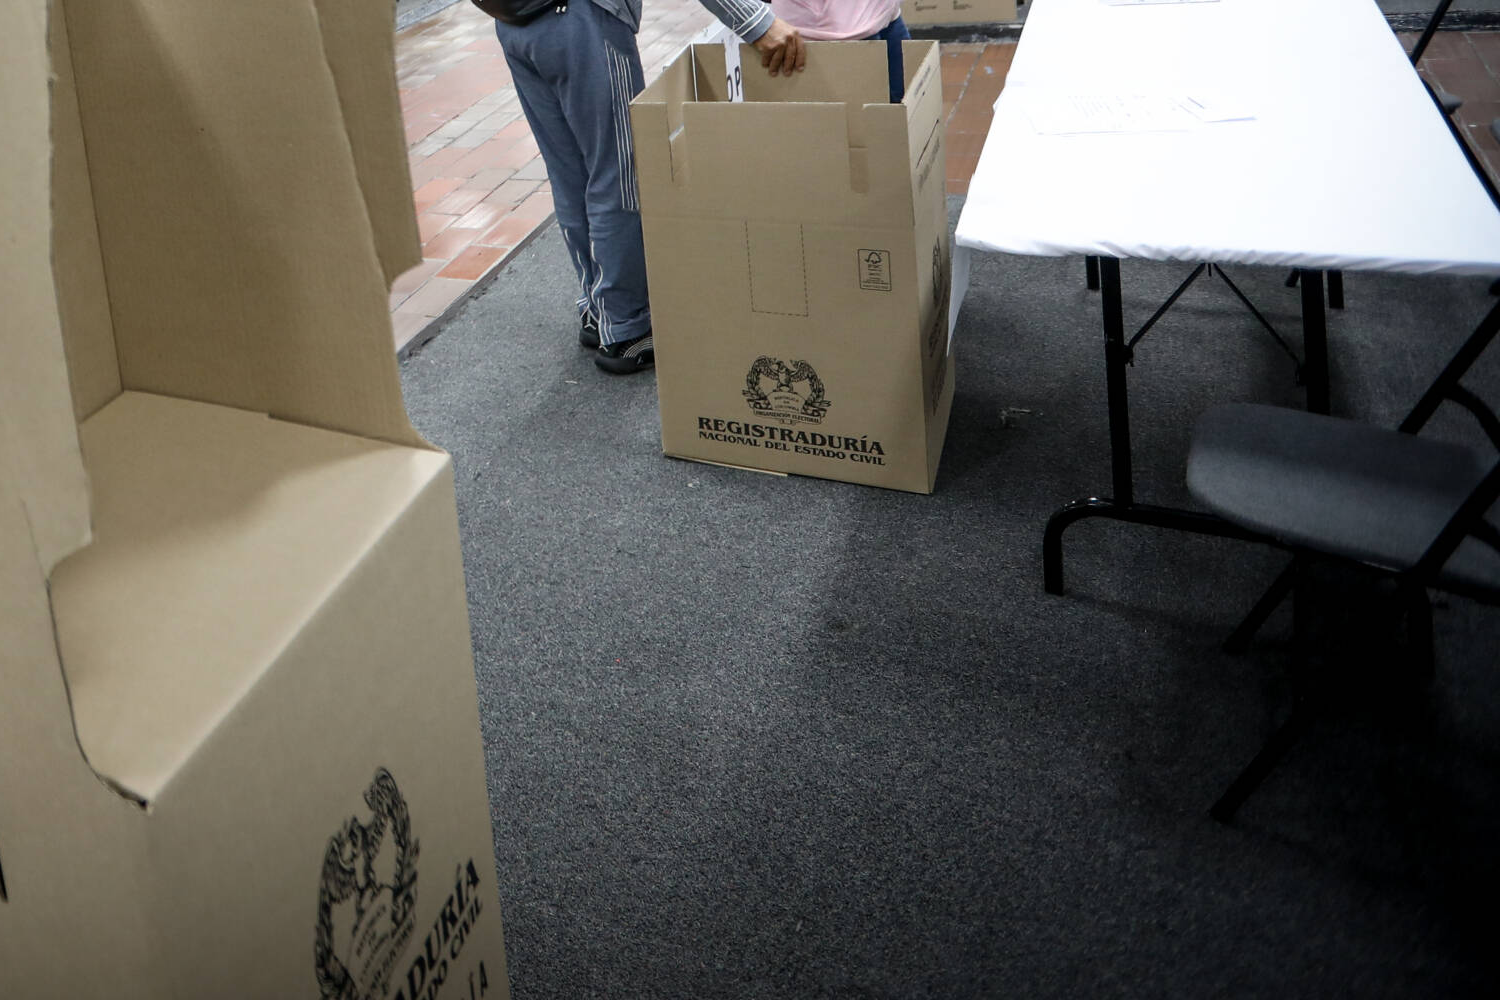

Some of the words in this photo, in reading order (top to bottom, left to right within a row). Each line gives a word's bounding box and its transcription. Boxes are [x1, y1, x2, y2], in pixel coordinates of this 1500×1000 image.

[698, 416, 886, 456] REGISTRADURÍA
[699, 430, 761, 447] NACIONAL
[764, 440, 790, 451] DEL
[794, 444, 846, 460] ESTADO
[849, 453, 886, 466] CIVIL
[450, 896, 484, 961] CIVIL
